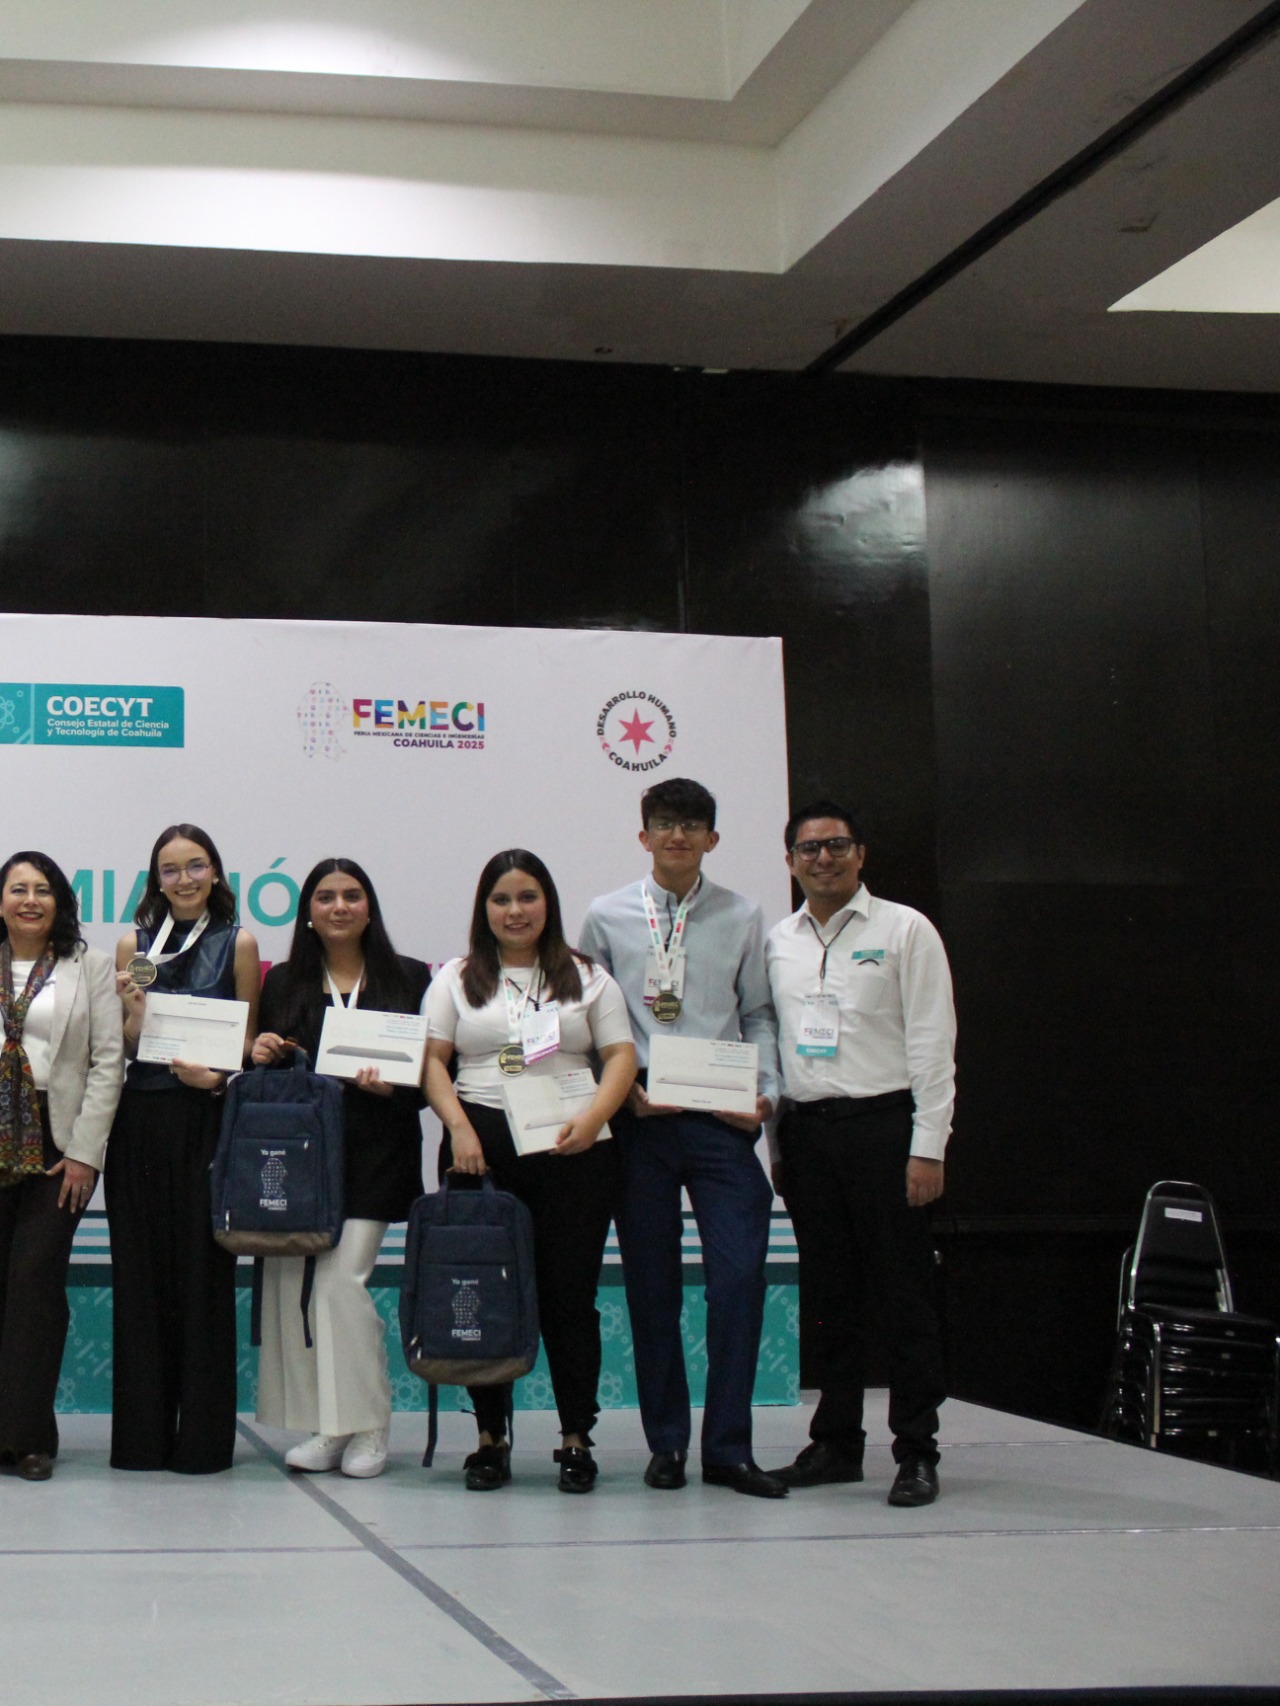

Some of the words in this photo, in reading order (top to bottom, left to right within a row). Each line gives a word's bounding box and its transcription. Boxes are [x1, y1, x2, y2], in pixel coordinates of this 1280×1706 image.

[47, 696, 153, 717] COECYT
[353, 699, 485, 731] FEMECI
[597, 691, 646, 736] DESARROLLO
[647, 695, 677, 738] HUMANO
[47, 718, 85, 728] Consejo
[87, 719, 119, 728] Estatal
[121, 719, 132, 728] de
[135, 720, 169, 729] Ciencia
[47, 728, 53, 737] y
[55, 727, 105, 738] Tecnología
[107, 728, 119, 737] de
[121, 728, 162, 738] Coahuila
[393, 739, 454, 748] COAHUILA
[457, 740, 485, 750] 2025
[608, 752, 668, 772] COAHUILA
[260, 1199, 287, 1207] FEMECI
[451, 1329, 481, 1337] FEMECI
